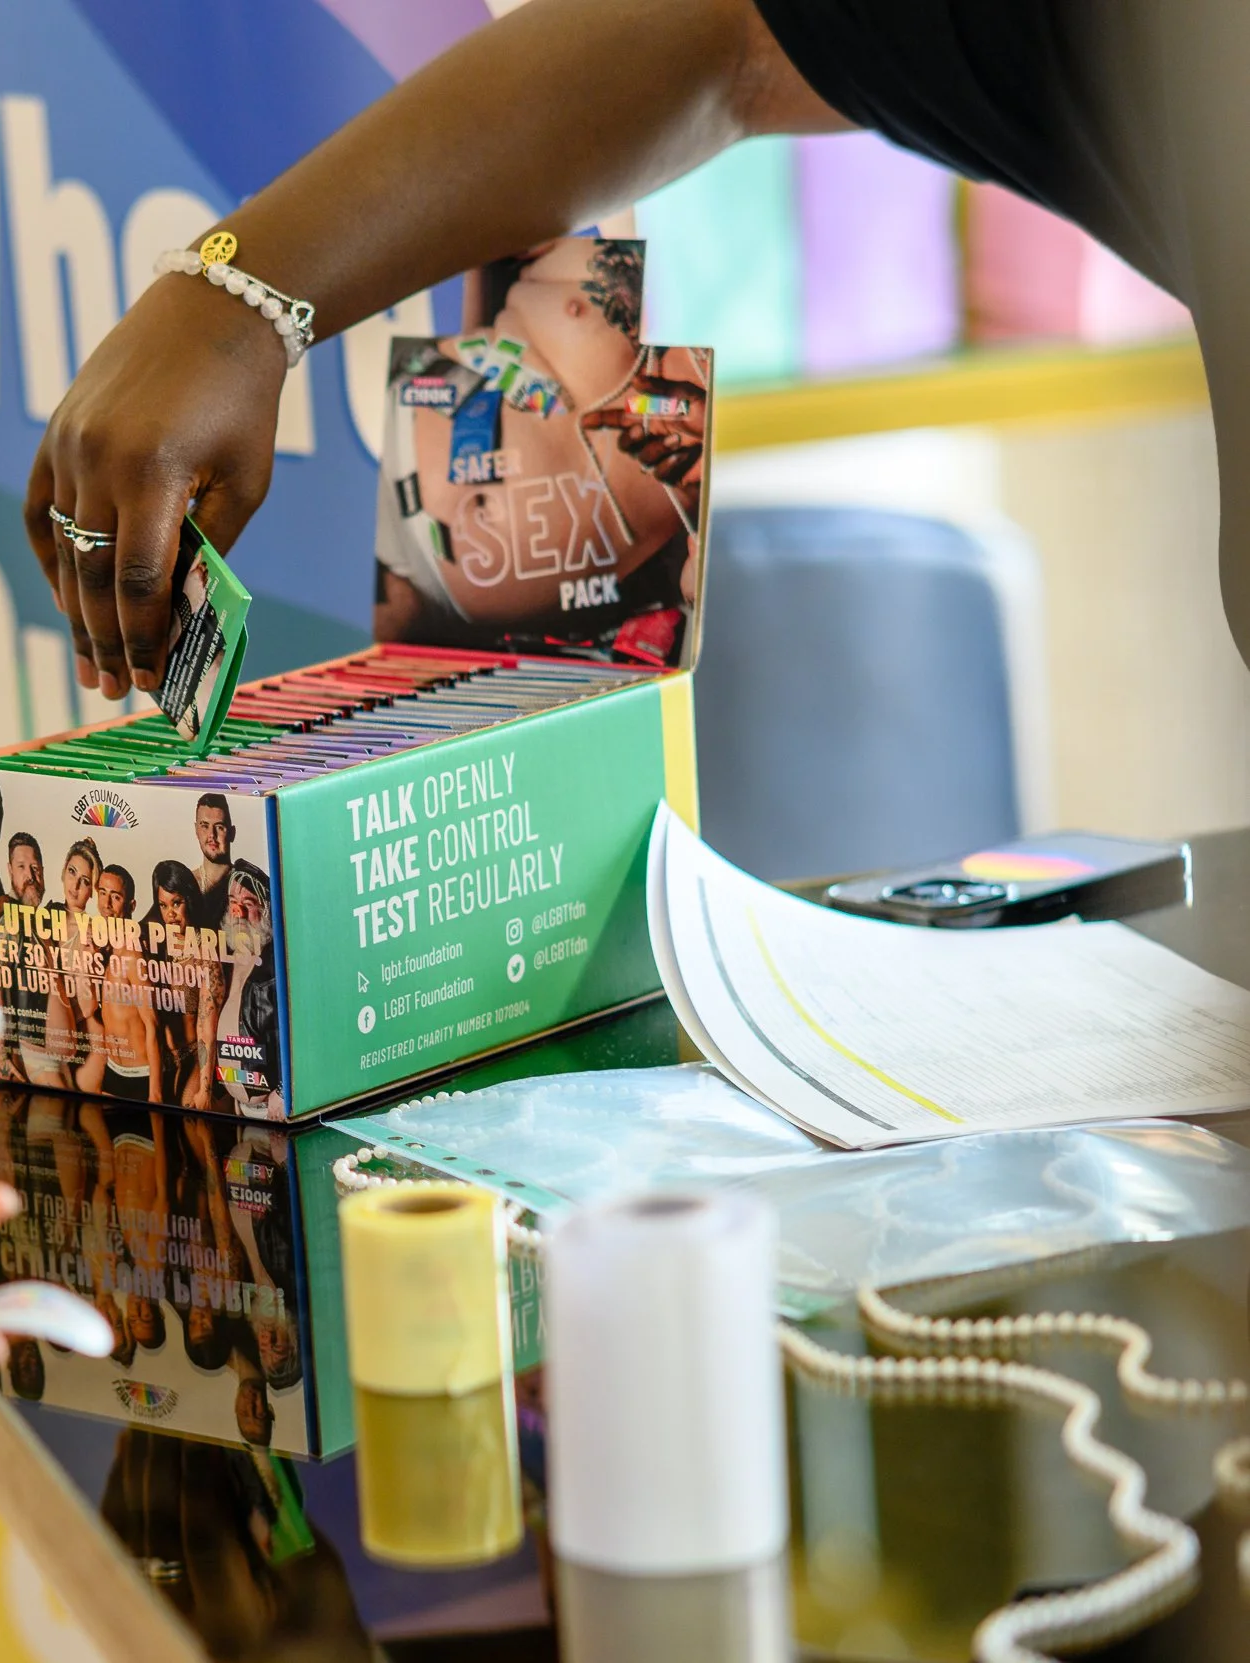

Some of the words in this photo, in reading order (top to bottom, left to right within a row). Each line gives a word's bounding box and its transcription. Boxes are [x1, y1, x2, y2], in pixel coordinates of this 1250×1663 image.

[452, 449, 522, 484] SAFER
[456, 471, 618, 588] SEX
[559, 572, 621, 612] PACK
[71, 794, 89, 823] LGBT
[89, 789, 139, 829] FOUNDATION
[346, 782, 418, 841] TALK
[423, 751, 516, 819] OPENLY
[349, 835, 421, 895] TAKE
[427, 800, 539, 872] CONTROL
[353, 888, 420, 949] TEST
[428, 843, 564, 926] REGULARLY
[531, 900, 587, 935] @LGBTfdn
[74, 911, 142, 952] YOUR
[148, 921, 263, 967] PEARLS!
[533, 936, 588, 971] @LGBTfdn
[23, 942, 46, 967] 30
[49, 946, 105, 976] YEARS
[109, 954, 134, 978] OF
[137, 958, 211, 989] CONDOM
[381, 941, 463, 986] lgbt.foundation
[16, 968, 59, 995] LUBE
[64, 974, 186, 1014] DISTRIBUTION
[384, 994, 411, 1020] LGBT
[414, 976, 474, 1011] Foundation
[220, 1043, 263, 1060] £100K
[228, 1036, 254, 1044] TARGET
[360, 1038, 415, 1071] REGISTERED
[417, 1026, 454, 1051] CHARITY
[456, 1012, 493, 1037] NUMBER
[494, 999, 531, 1023] 1070904
